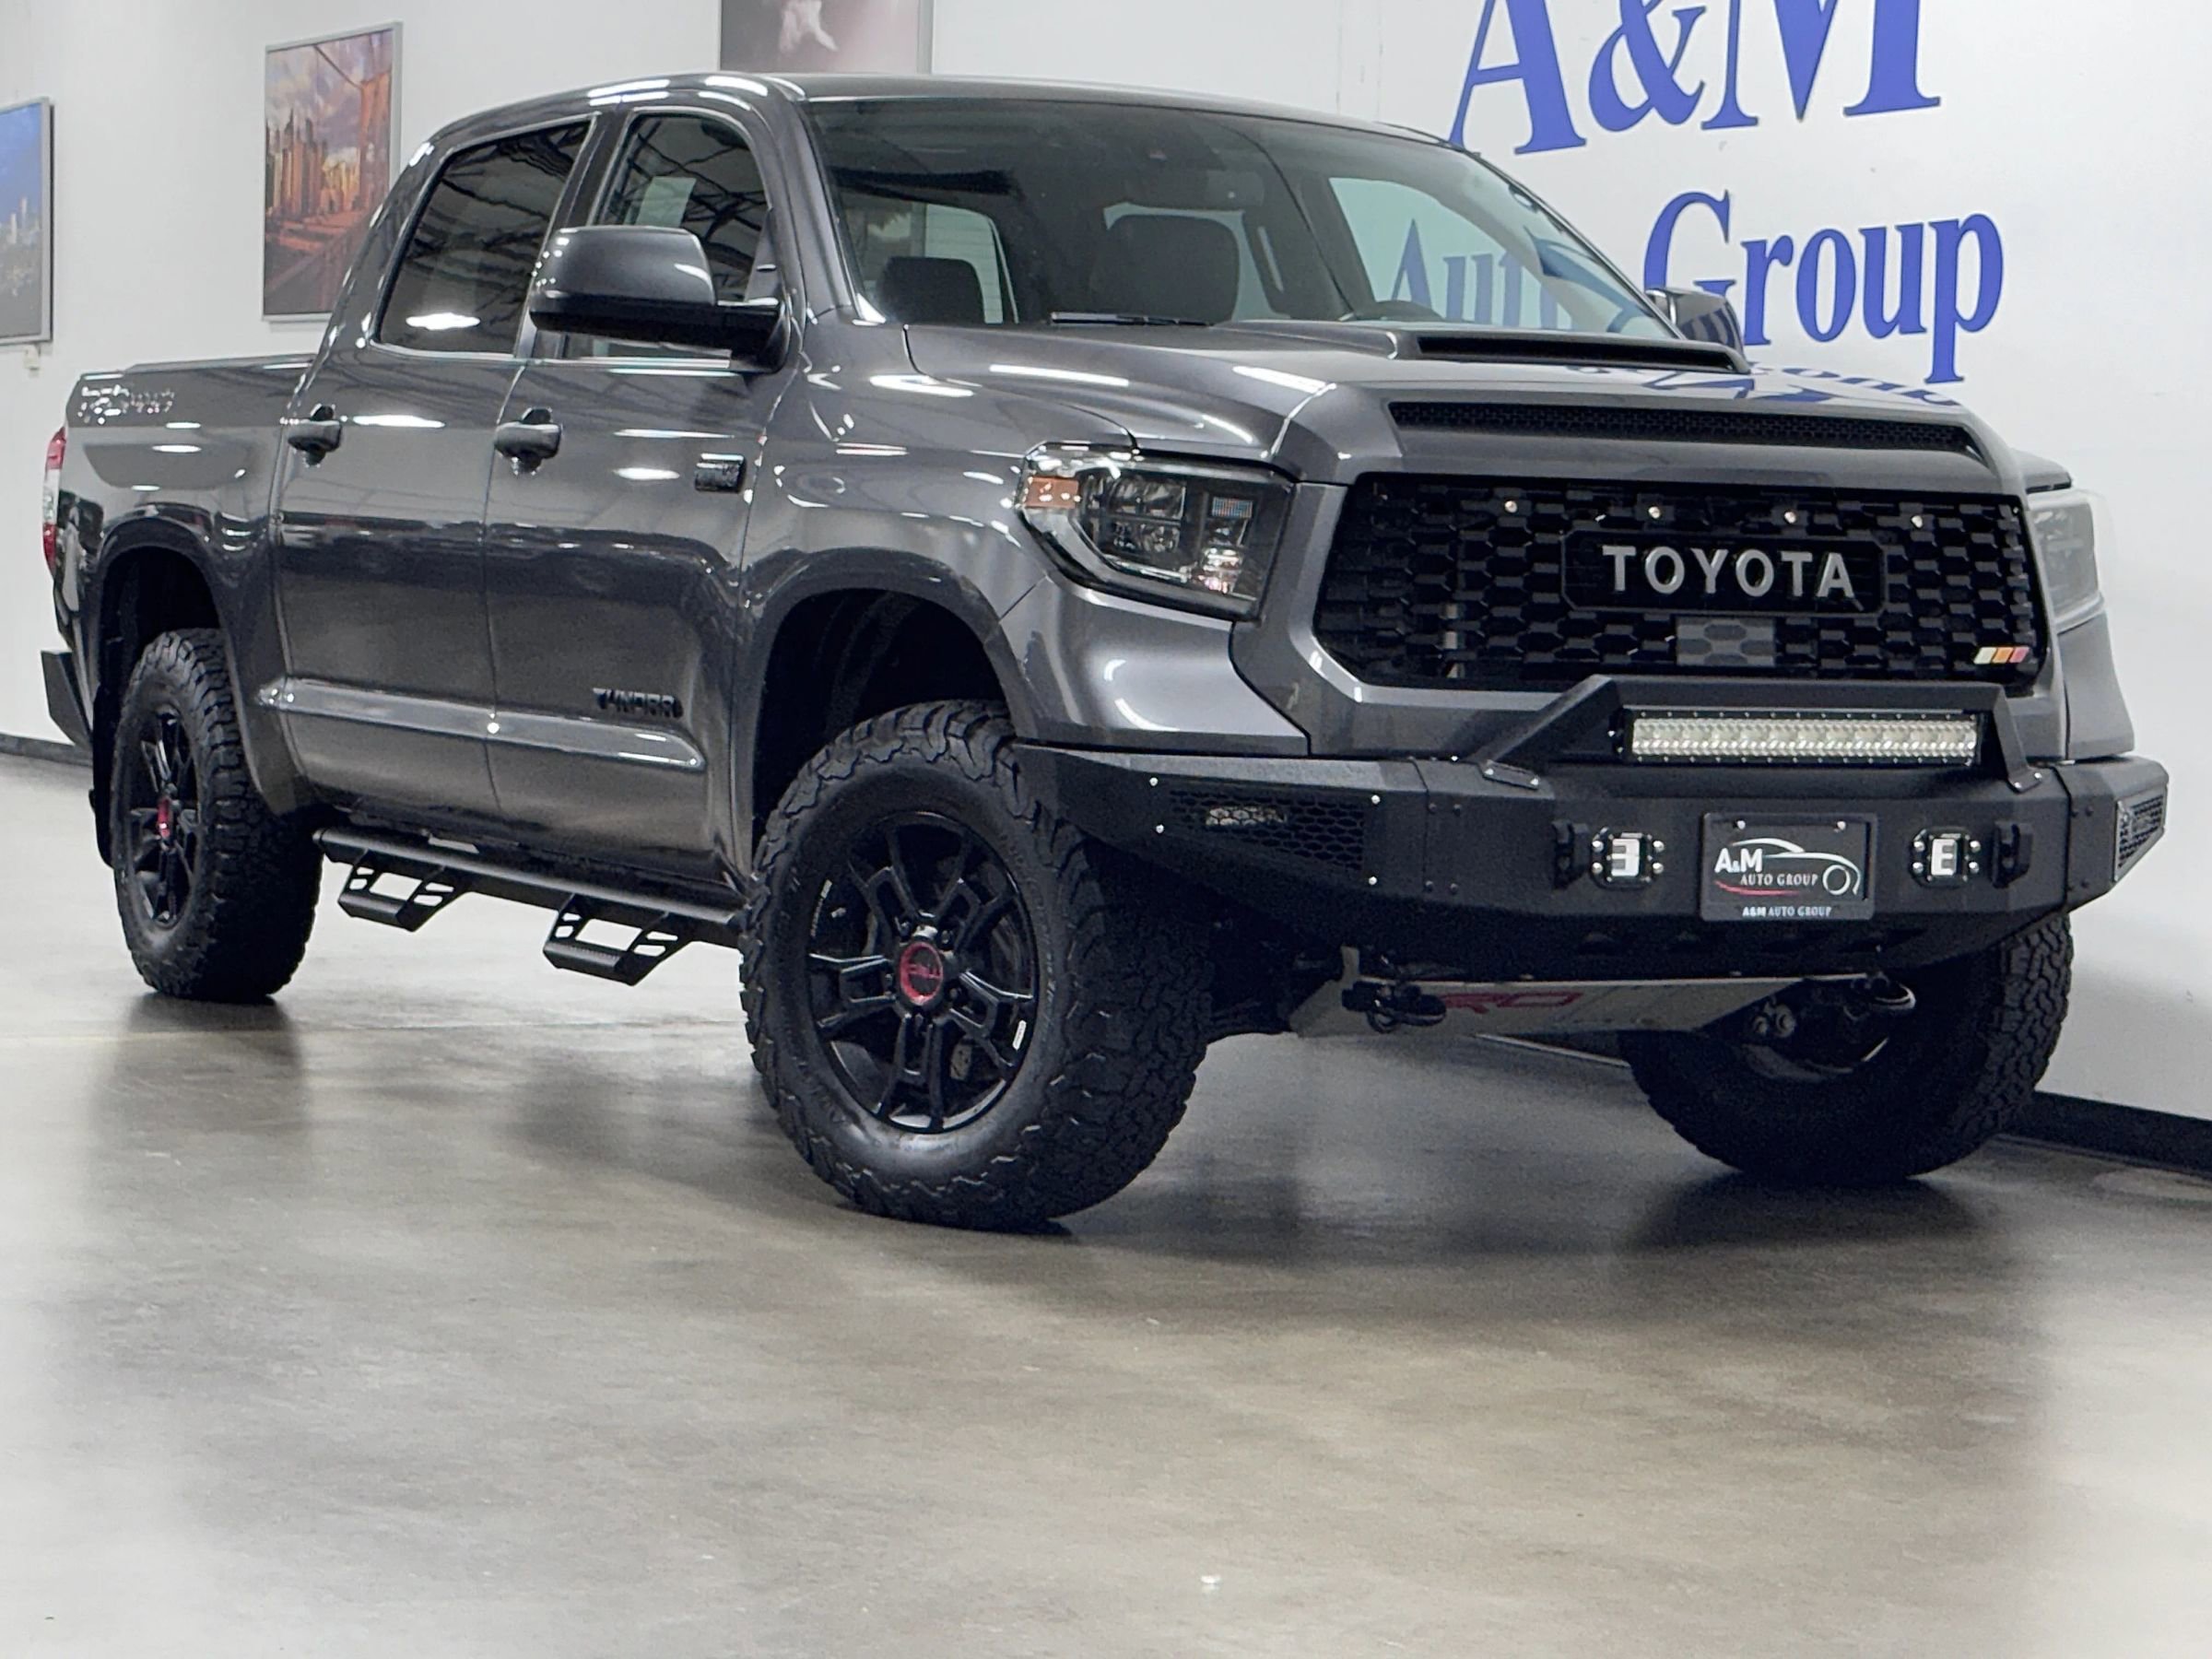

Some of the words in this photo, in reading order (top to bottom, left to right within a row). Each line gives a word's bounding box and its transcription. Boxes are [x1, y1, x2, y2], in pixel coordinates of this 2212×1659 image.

[1449, 0, 1941, 155] A&M
[1643, 190, 2004, 384] Group
[1602, 545, 1856, 598] TOYOTA
[1714, 847, 1763, 873] A&M
[1740, 873, 1773, 887] AUTO
[1776, 873, 1818, 887] GROUP
[1742, 906, 1767, 917] A&M
[1768, 906, 1795, 917] AUTO
[1797, 906, 1832, 917] GROUP
